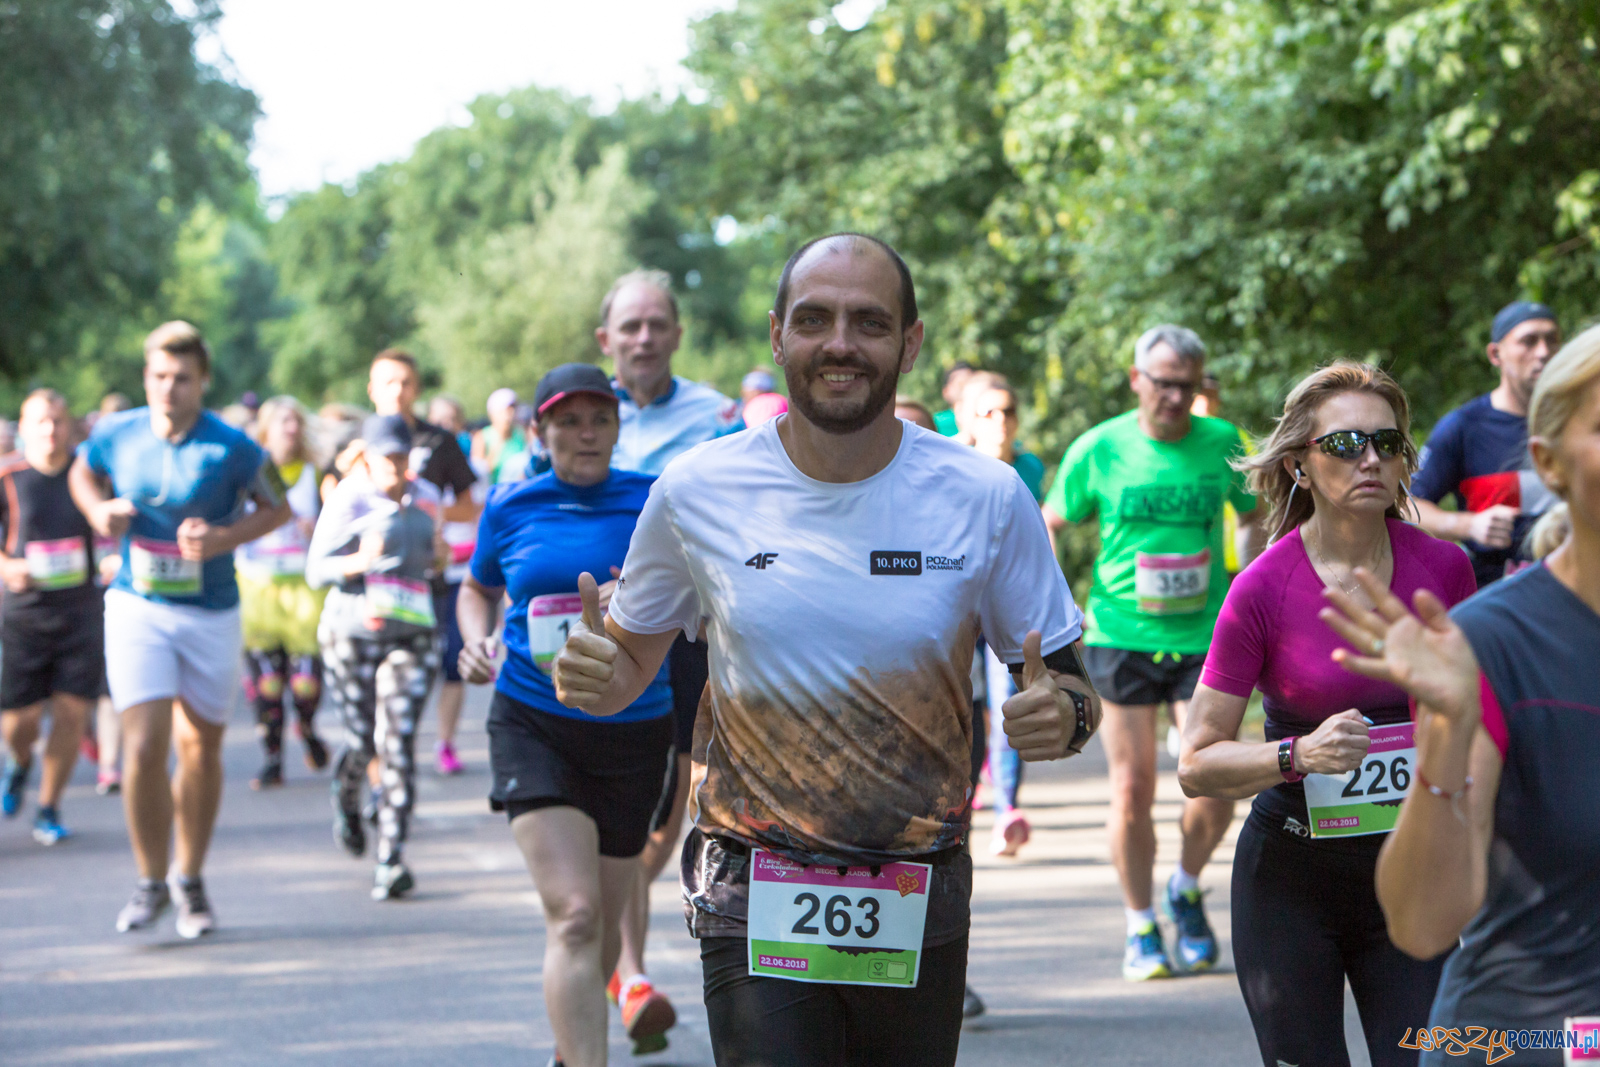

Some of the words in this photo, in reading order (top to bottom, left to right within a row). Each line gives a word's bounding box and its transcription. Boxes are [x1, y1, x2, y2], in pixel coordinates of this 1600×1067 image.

[745, 552, 779, 570] 4F
[876, 557, 891, 568] 10.
[893, 557, 918, 569] PKO
[1370, 735, 1405, 744] EKOLADOWY.PL
[1341, 757, 1410, 798] 226
[1319, 818, 1358, 828] 22.06.2018
[791, 892, 880, 939] 263
[760, 956, 806, 969] 22.06.2018
